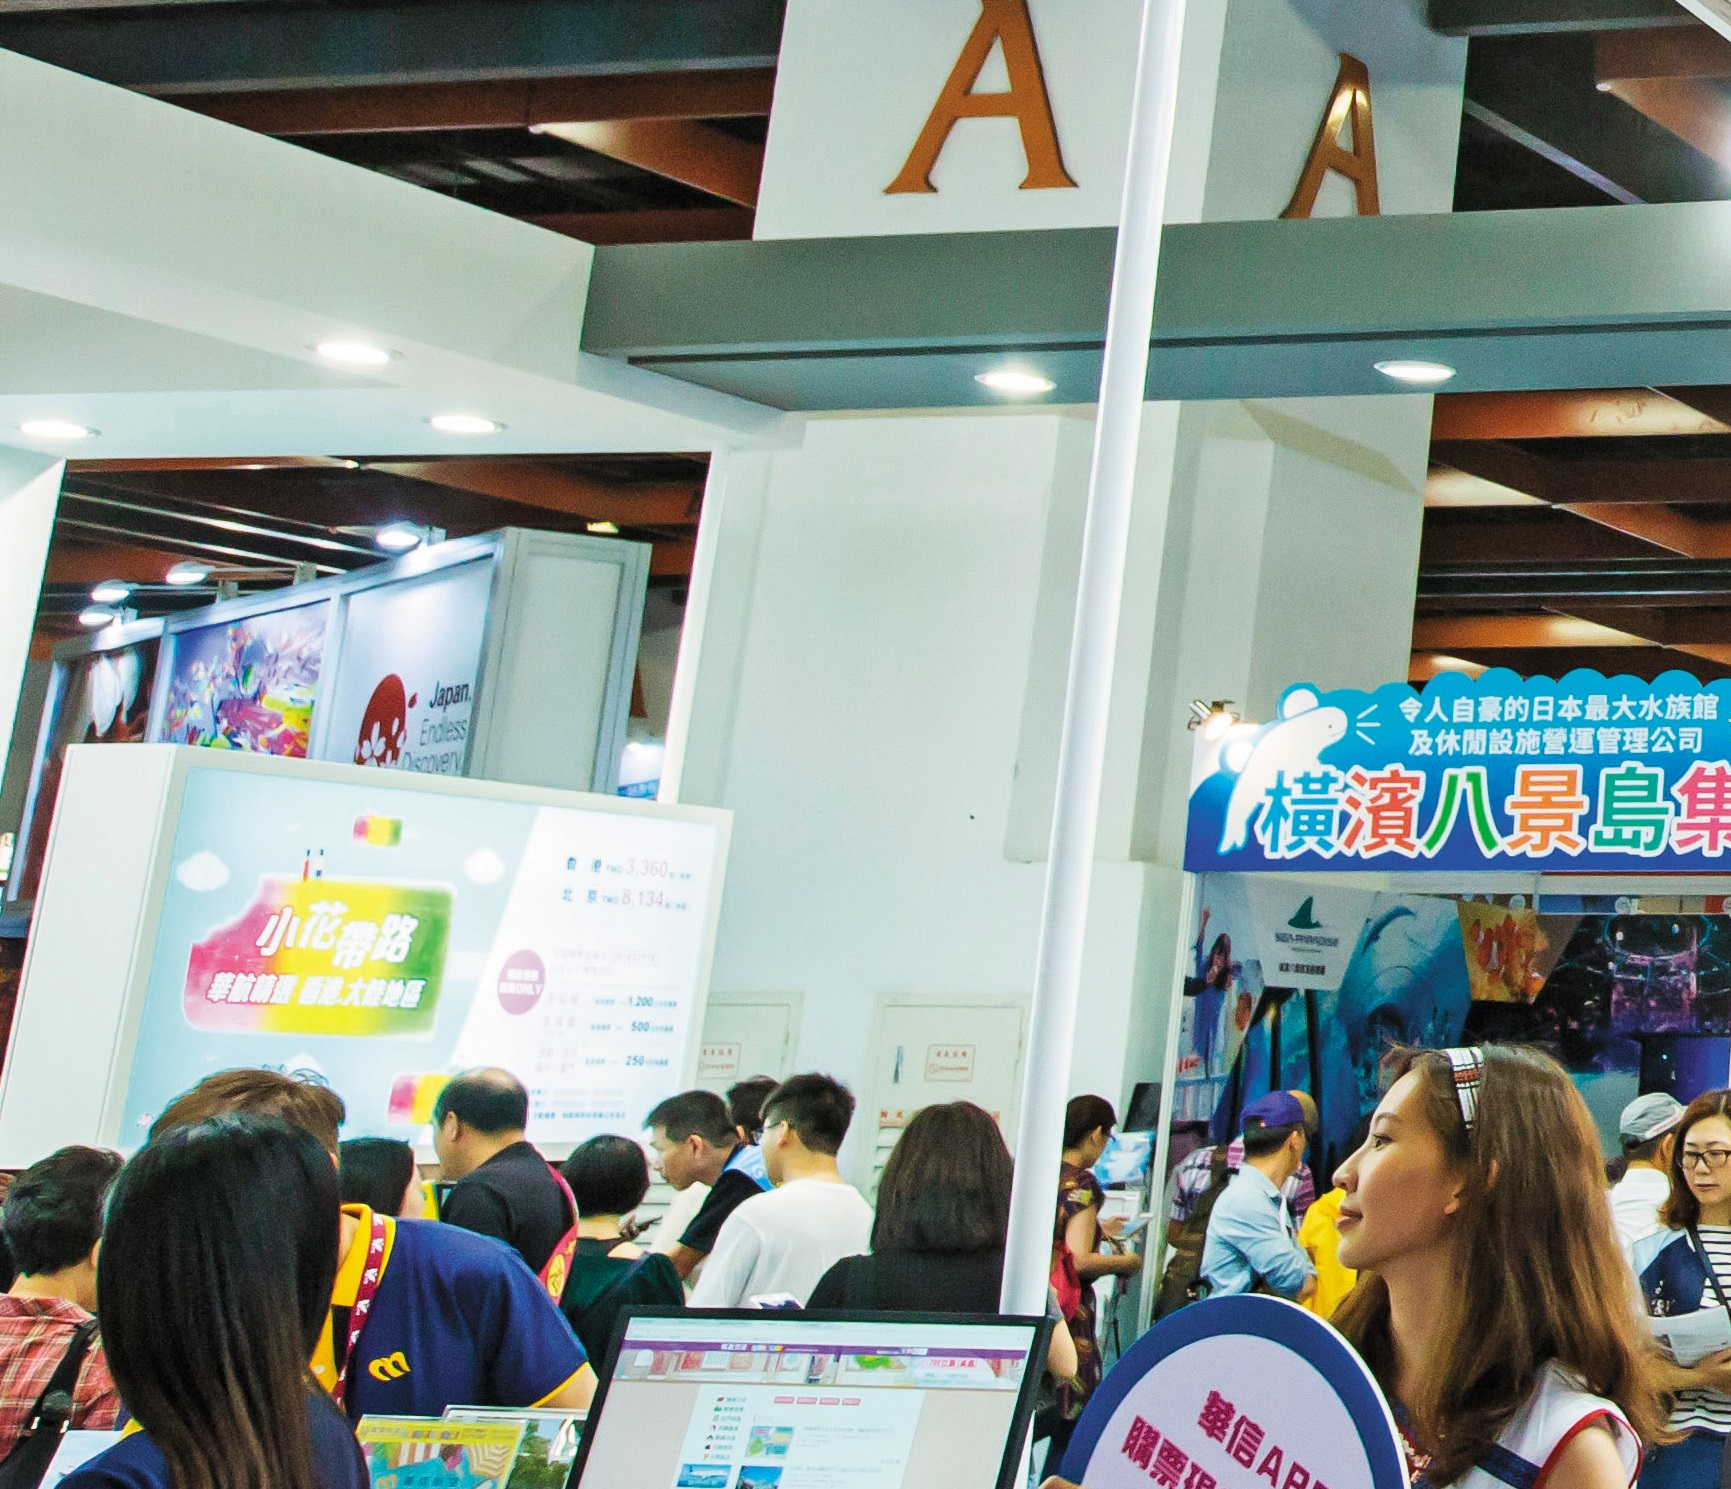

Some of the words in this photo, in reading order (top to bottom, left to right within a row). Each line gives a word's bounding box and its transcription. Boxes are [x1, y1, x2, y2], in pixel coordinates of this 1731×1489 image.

[1279, 53, 1380, 219] A
[1399, 693, 1719, 723] 令人自豪的日本最大水族館
[420, 715, 467, 746] Endless
